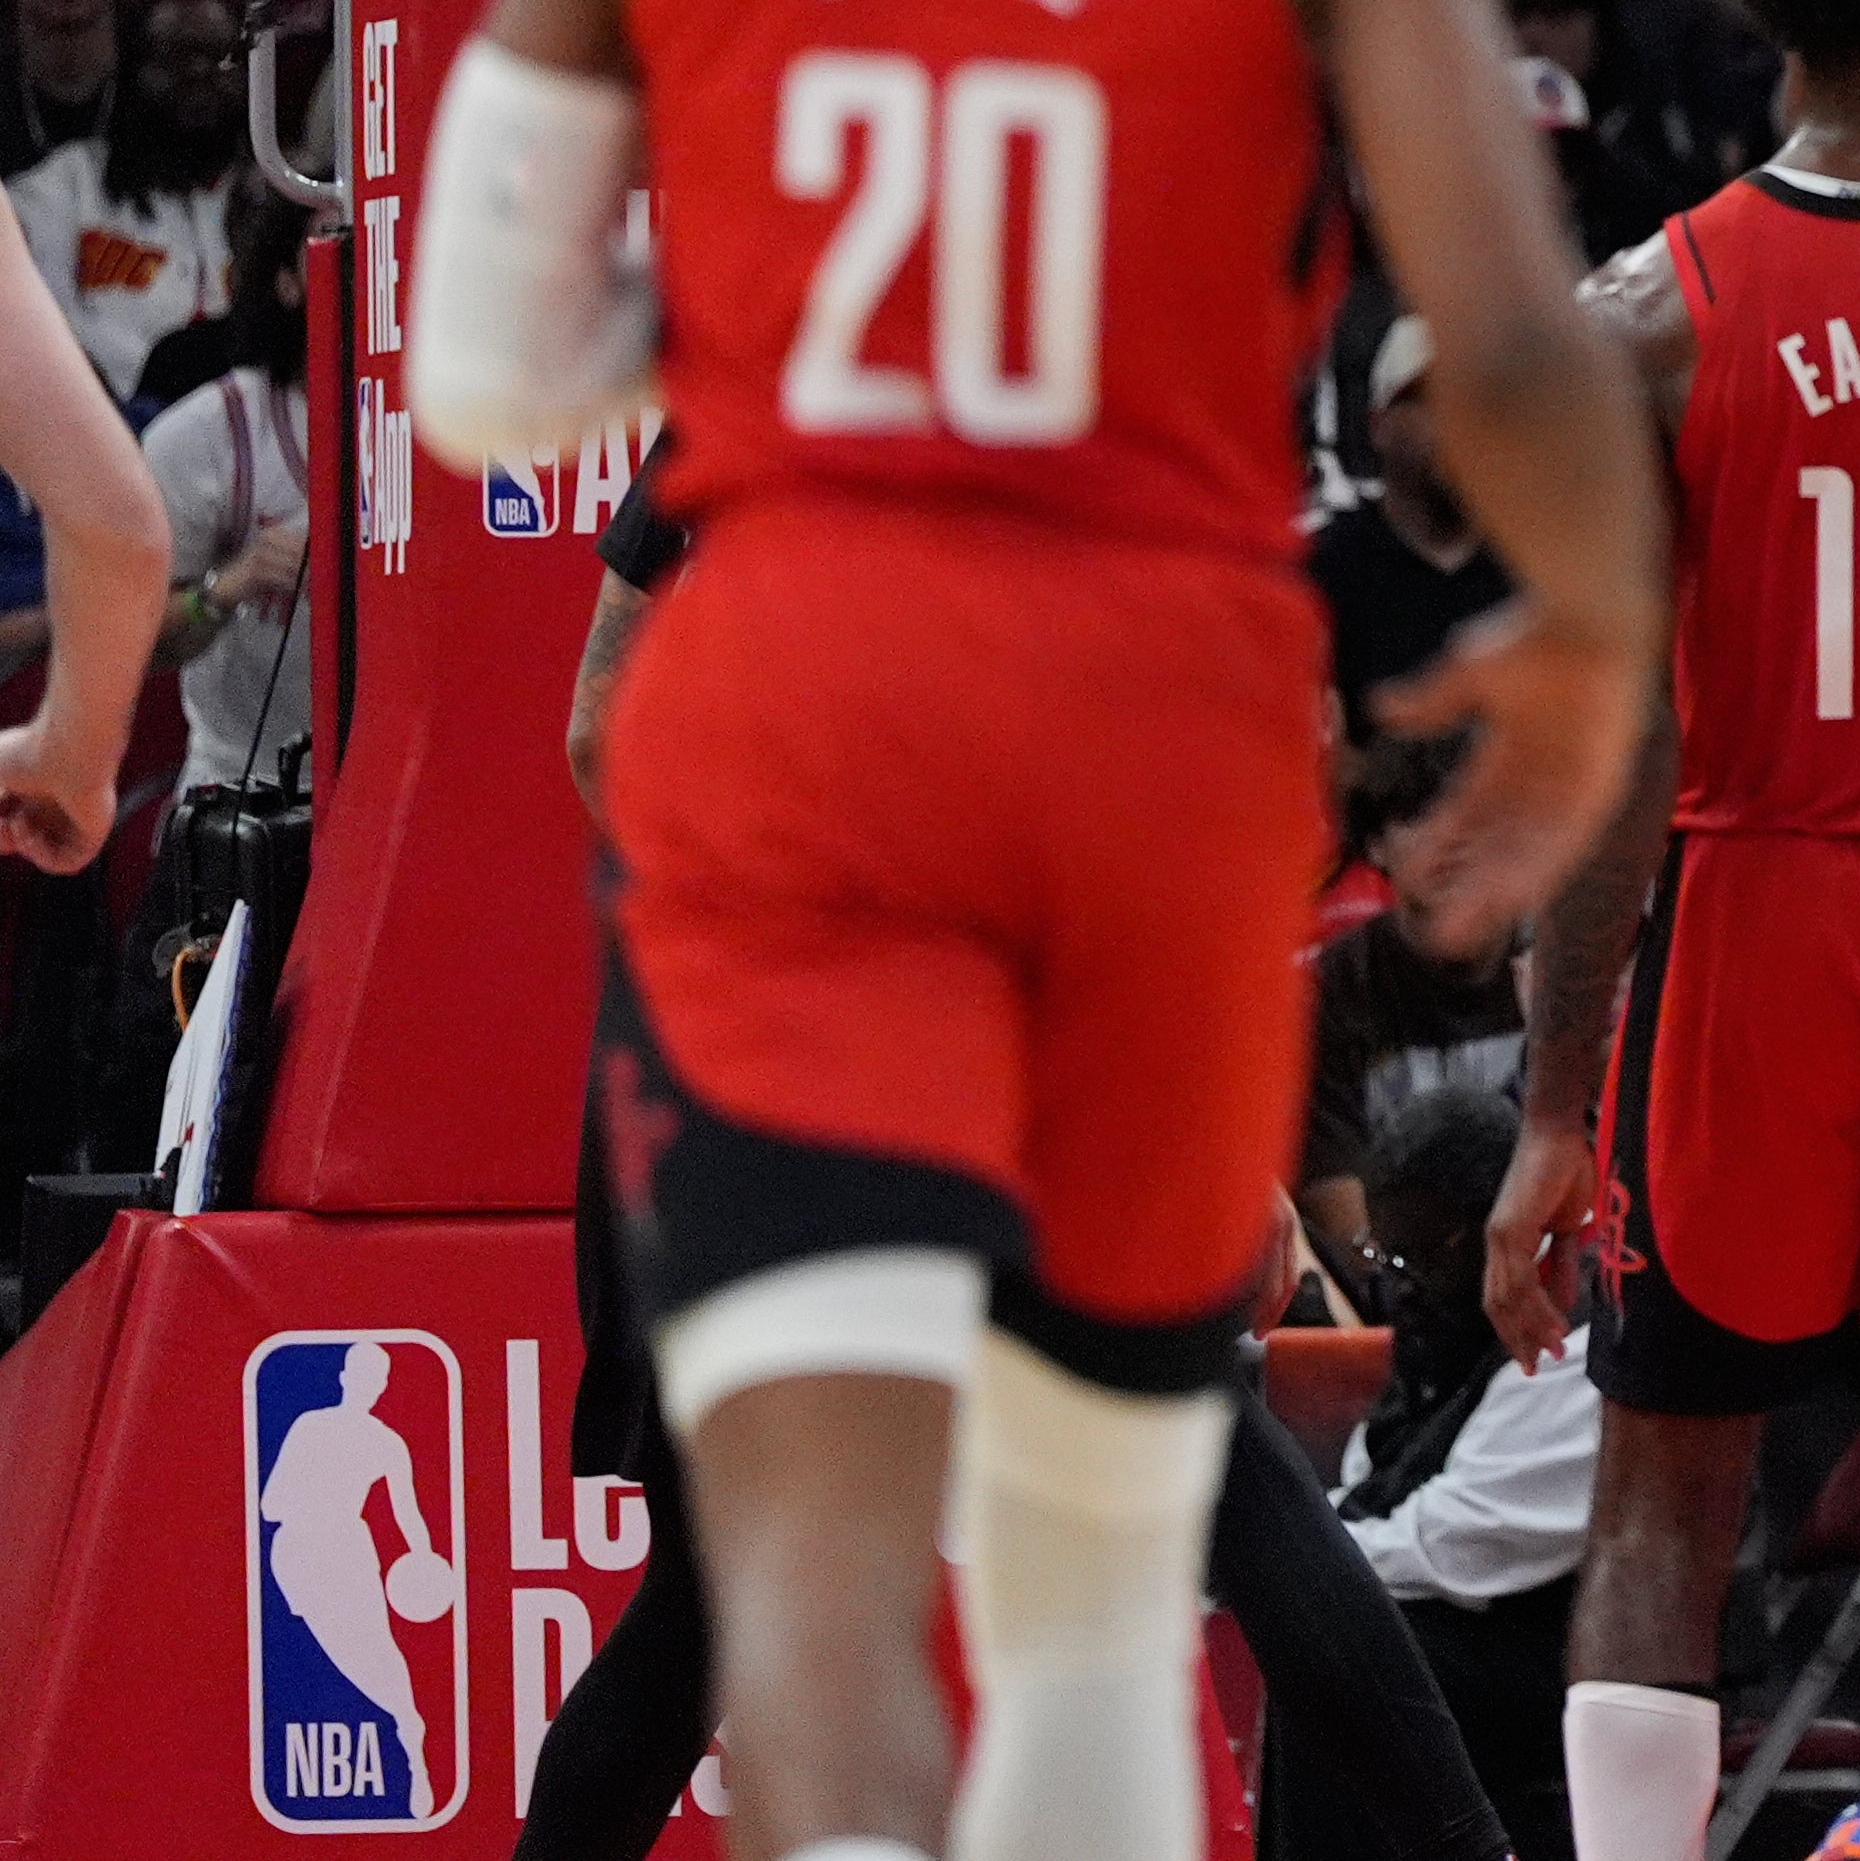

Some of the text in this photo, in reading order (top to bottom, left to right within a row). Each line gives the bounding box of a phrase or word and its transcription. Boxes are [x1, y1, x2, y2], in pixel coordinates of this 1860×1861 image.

[362, 19, 399, 181] GET
[363, 196, 401, 355] THE
[772, 46, 1113, 449] 20
[494, 498, 531, 527] NBA
[284, 1722, 385, 1799] NBA
